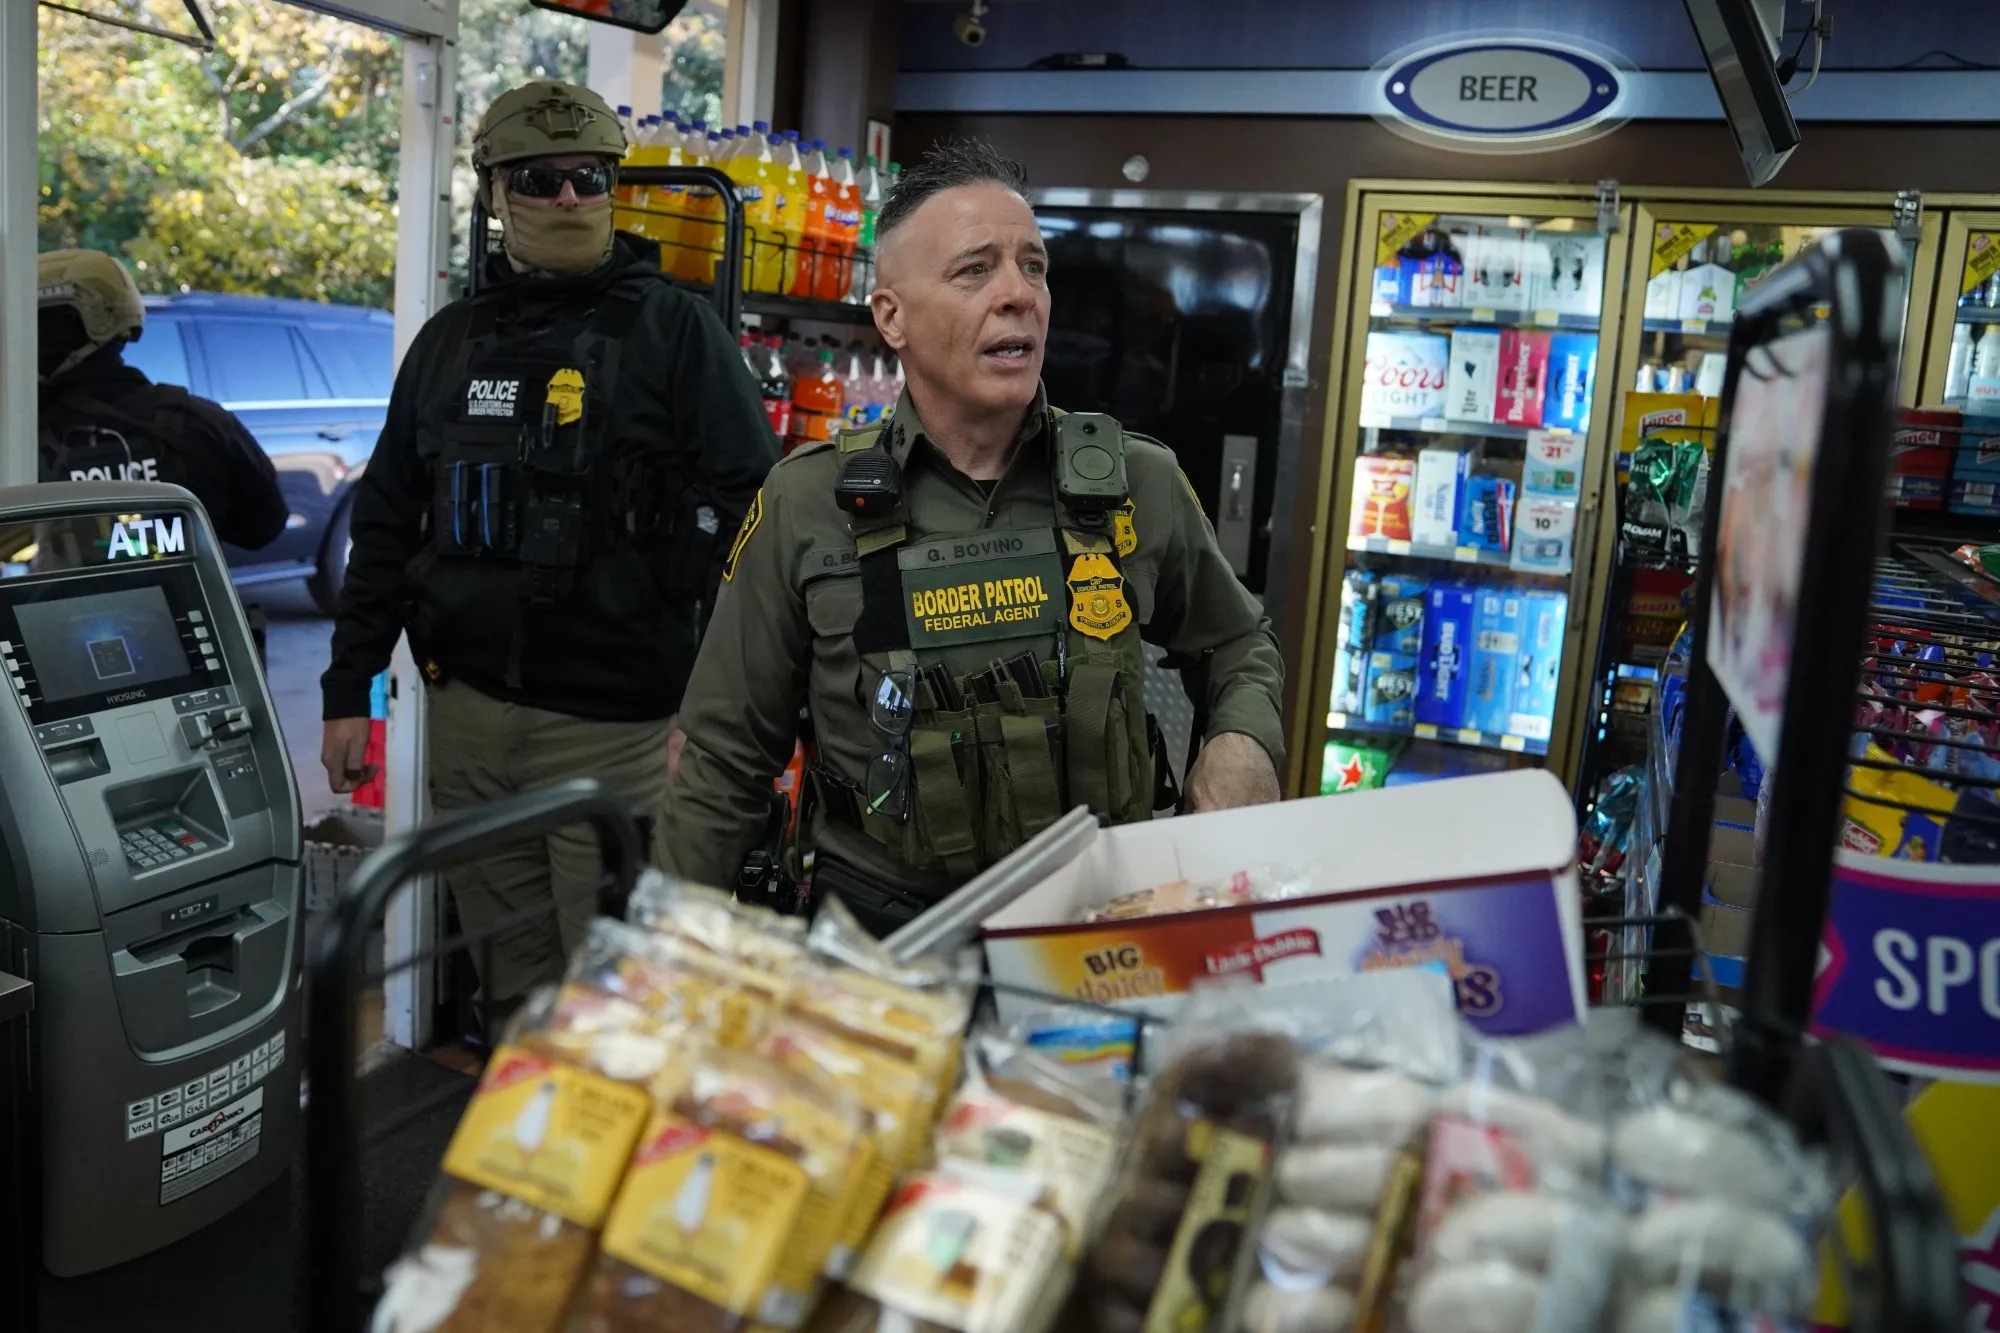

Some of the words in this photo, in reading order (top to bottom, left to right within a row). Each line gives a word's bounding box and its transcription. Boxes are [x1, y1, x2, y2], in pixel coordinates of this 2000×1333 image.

[1459, 75, 1538, 102] BEER
[1363, 355, 1446, 390] Coors
[1508, 341, 1531, 421] Budweiser
[468, 380, 519, 400] POLICE
[1371, 391, 1430, 406] LIGHT
[468, 408, 486, 416] BORDER
[486, 409, 514, 417] PROTECTION
[1642, 412, 1684, 427] Lance
[107, 517, 185, 560] ATM
[1124, 526, 1131, 535] S
[928, 549, 946, 562] G.
[954, 538, 1024, 559] BOVINO
[1076, 585, 1098, 593] BORDER
[1089, 578, 1103, 586] CBP
[912, 583, 983, 618] BORDER
[984, 575, 1049, 608] PATROL
[1077, 602, 1084, 612] U
[1115, 599, 1123, 608] S
[924, 612, 992, 632] FEDERAL
[994, 604, 1041, 624] AGENT
[1079, 616, 1105, 629] PATROL
[1105, 612, 1125, 628] AGENT
[1440, 621, 1456, 654] BUD
[1435, 653, 1454, 701] LIGHT
[106, 689, 146, 705] HYOSUNG
[1086, 947, 1139, 976] BIG
[186, 1104, 204, 1116] STAR
[131, 1121, 153, 1134] VISA
[164, 1114, 180, 1125] PLUS
